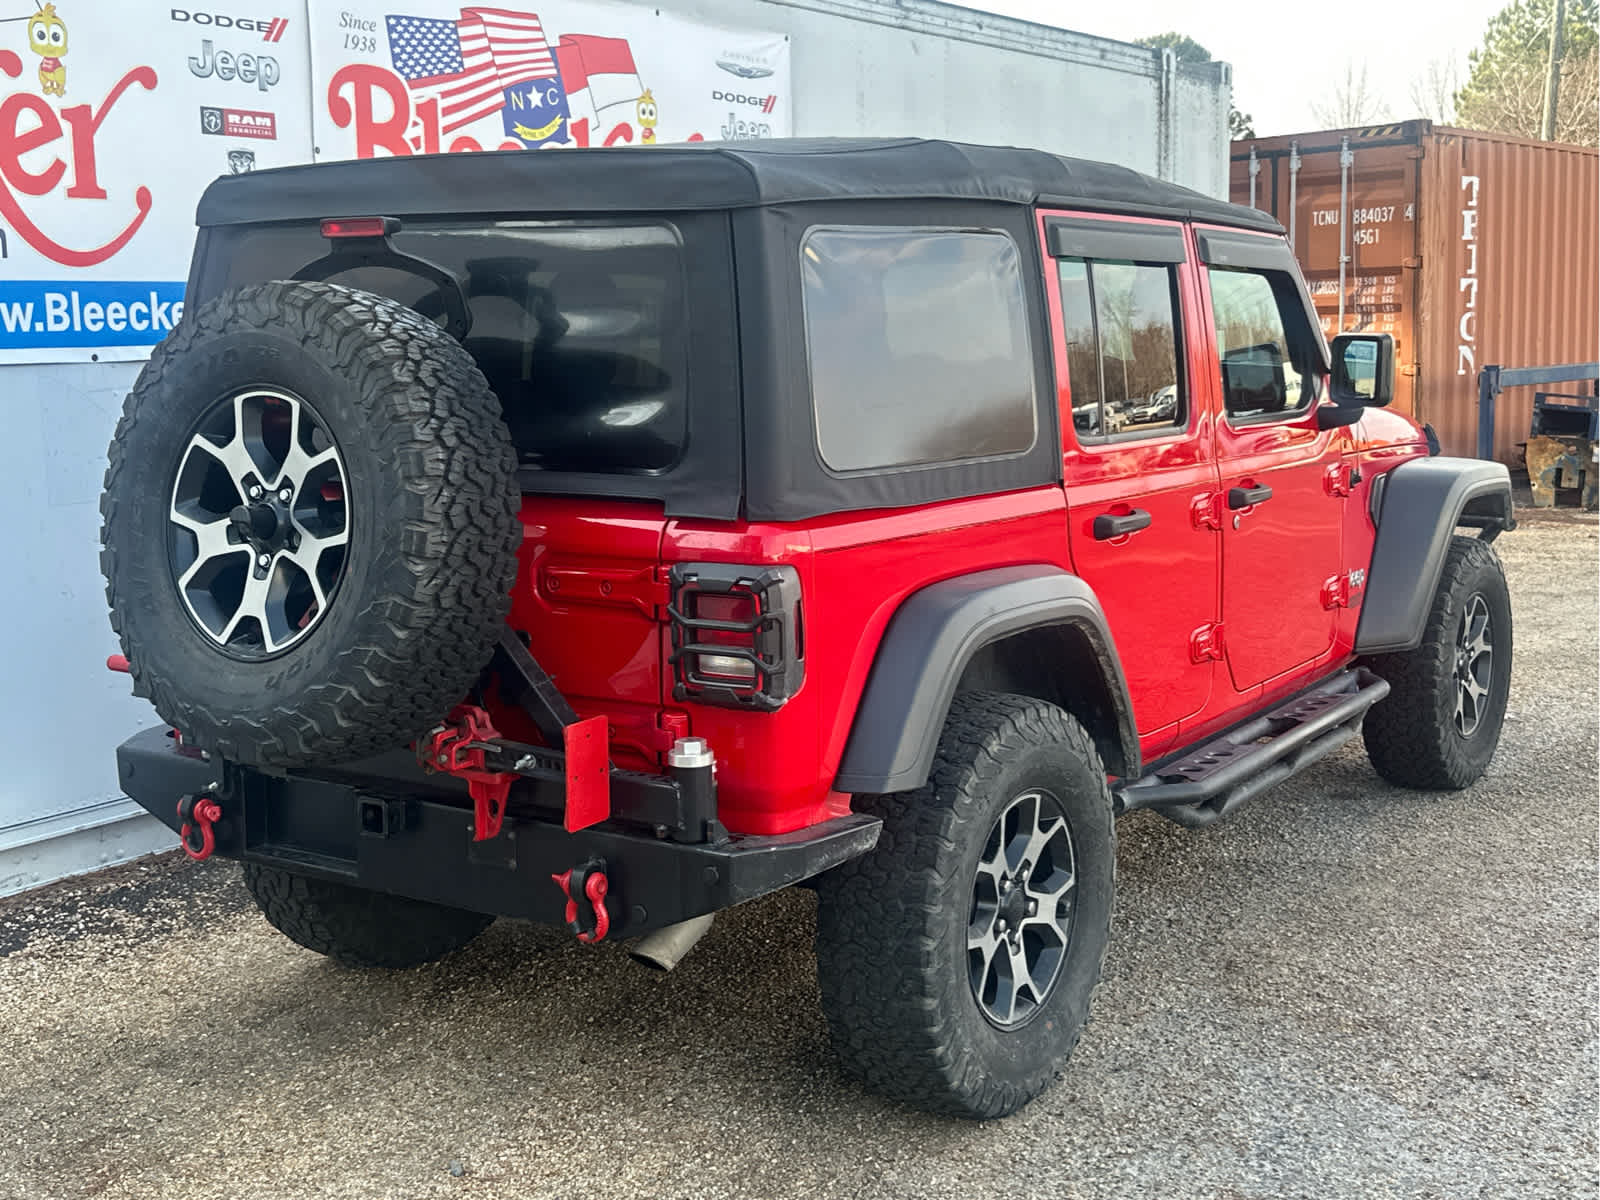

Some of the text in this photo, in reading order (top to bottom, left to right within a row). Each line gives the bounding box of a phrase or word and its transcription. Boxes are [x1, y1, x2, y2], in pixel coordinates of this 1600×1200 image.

[171, 9, 274, 33] DODGE
[340, 12, 377, 33] Since
[343, 33, 377, 54] 1938
[188, 39, 280, 92] Jeep
[712, 90, 769, 108] DODGE
[227, 114, 272, 127] RAM
[1312, 203, 1415, 226] TCNU 884037 4
[1353, 228, 1380, 245] 45G1
